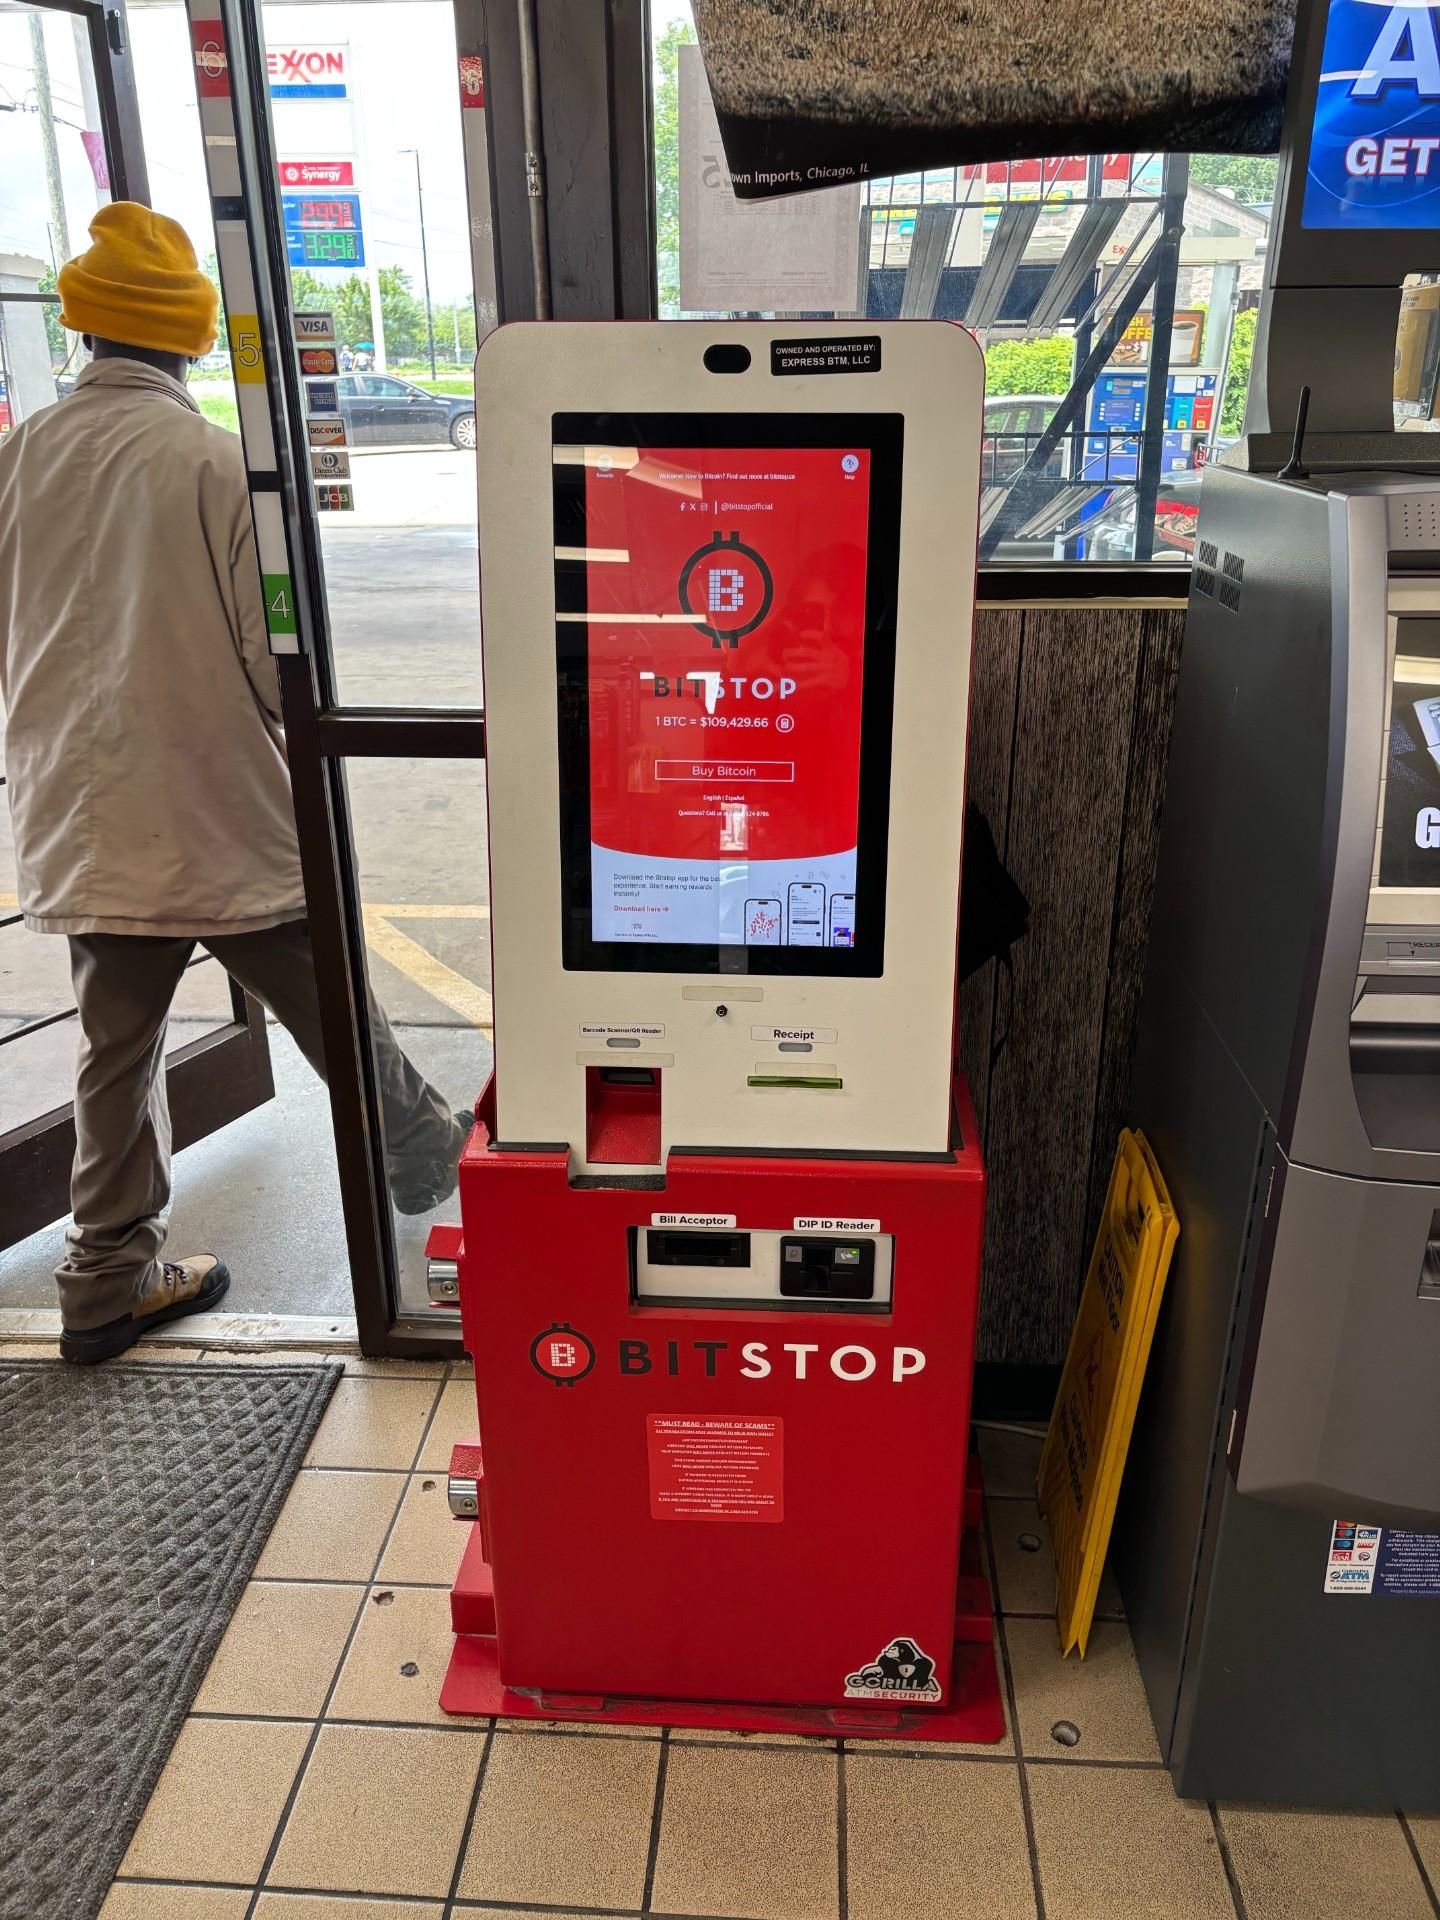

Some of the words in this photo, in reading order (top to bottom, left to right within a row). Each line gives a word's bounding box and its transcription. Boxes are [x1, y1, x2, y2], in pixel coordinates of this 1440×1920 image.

[266, 49, 344, 83] EXXON
[1345, 137, 1440, 175] GET
[301, 167, 341, 182] Synergy
[730, 172, 751, 184] own
[755, 170, 803, 187] Imports,
[807, 166, 856, 179] Chicago,
[860, 162, 870, 174] IL
[300, 320, 329, 332] VISA
[238, 332, 260, 367] 5
[776, 347, 804, 355] OWNED
[805, 346, 821, 354] AND
[822, 344, 862, 353] OPERATED
[863, 344, 876, 352] BY:
[781, 357, 825, 368] EXPRESS
[827, 356, 850, 367] BTM,
[852, 355, 871, 365] LLC
[319, 493, 349, 503] JCB
[721, 502, 774, 512] @bitstopofficial
[270, 590, 291, 619] 4
[655, 716, 660, 727] 1
[663, 716, 687, 727] BTC
[700, 716, 769, 728] $109,429.66
[692, 765, 714, 778] Buy
[717, 766, 756, 777] Bitcoin
[703, 794, 722, 802] English
[773, 1029, 815, 1041] Receipt
[659, 1215, 677, 1225] Bill
[679, 1215, 729, 1227] Acceptor
[798, 1220, 819, 1229] DIP
[821, 1221, 833, 1230] ID
[835, 1221, 876, 1231] Reader
[618, 1339, 927, 1383] BITSTOP
[1340, 1572, 1370, 1580] ATM
[847, 1675, 939, 1692] GORILLA
